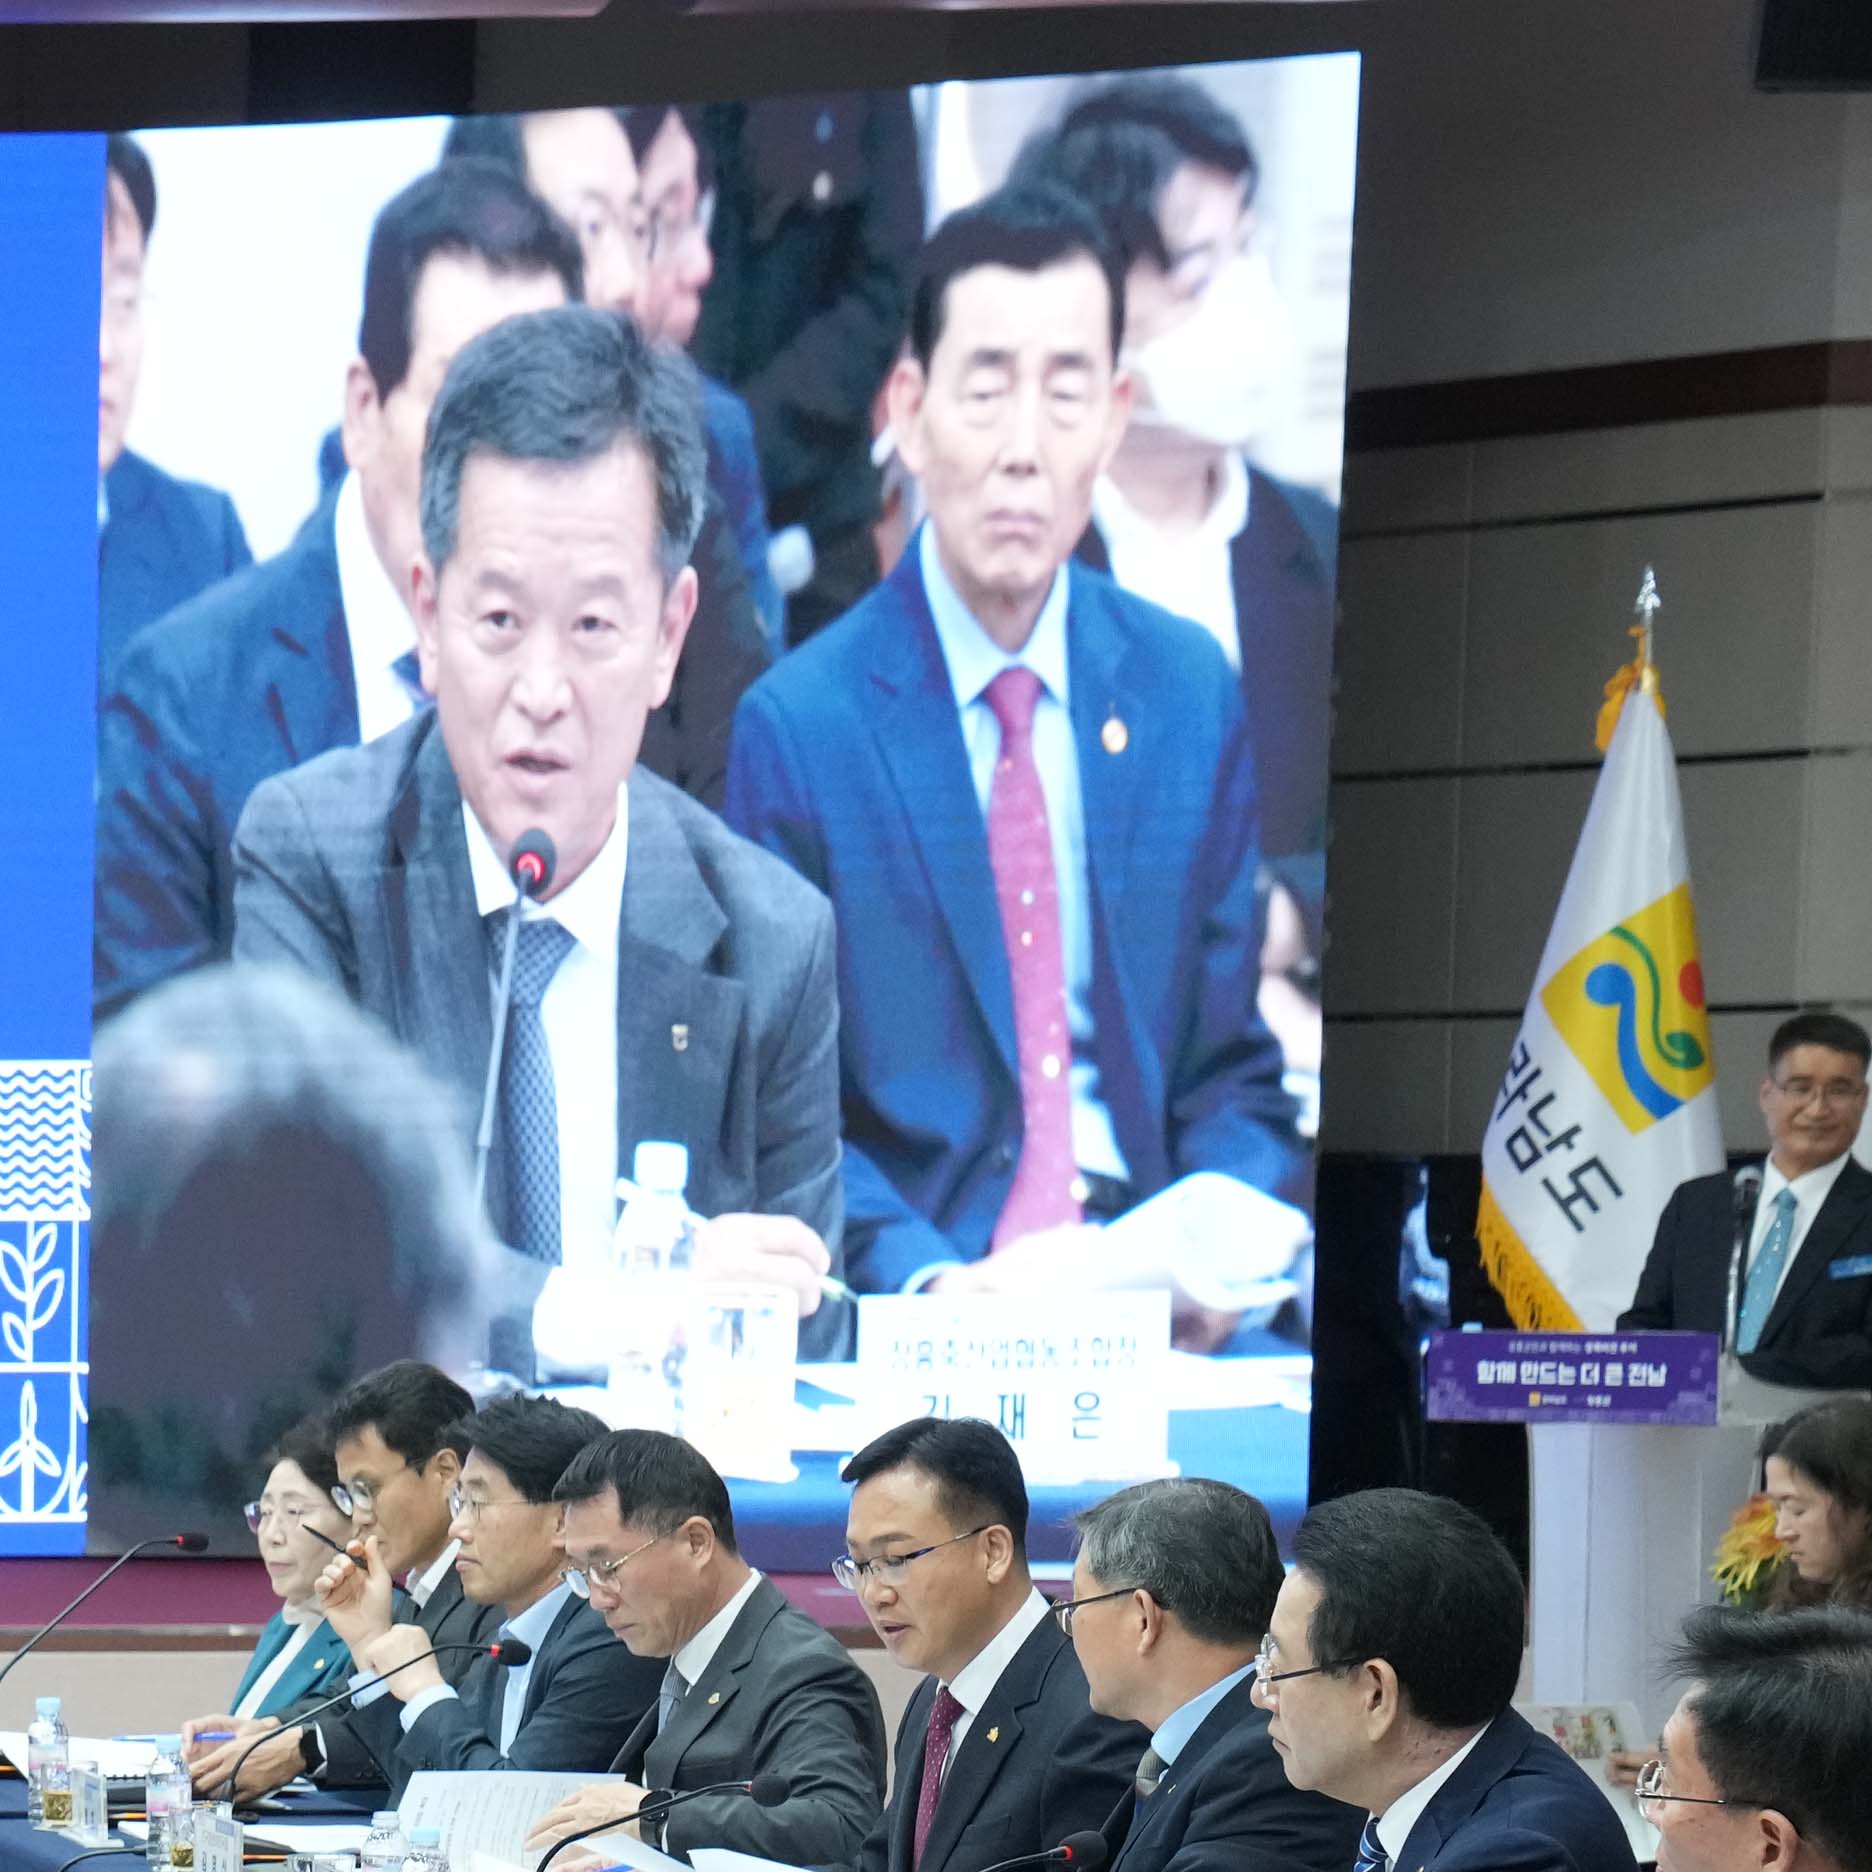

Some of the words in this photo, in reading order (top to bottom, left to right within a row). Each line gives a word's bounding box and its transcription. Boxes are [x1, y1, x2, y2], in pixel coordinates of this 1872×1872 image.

[1496, 1040, 1624, 1233] 라남도
[1477, 1361, 1517, 1385] 함께
[1520, 1361, 1576, 1386] 만드는
[1581, 1363, 1600, 1386] 더
[1628, 1363, 1667, 1388] 전남
